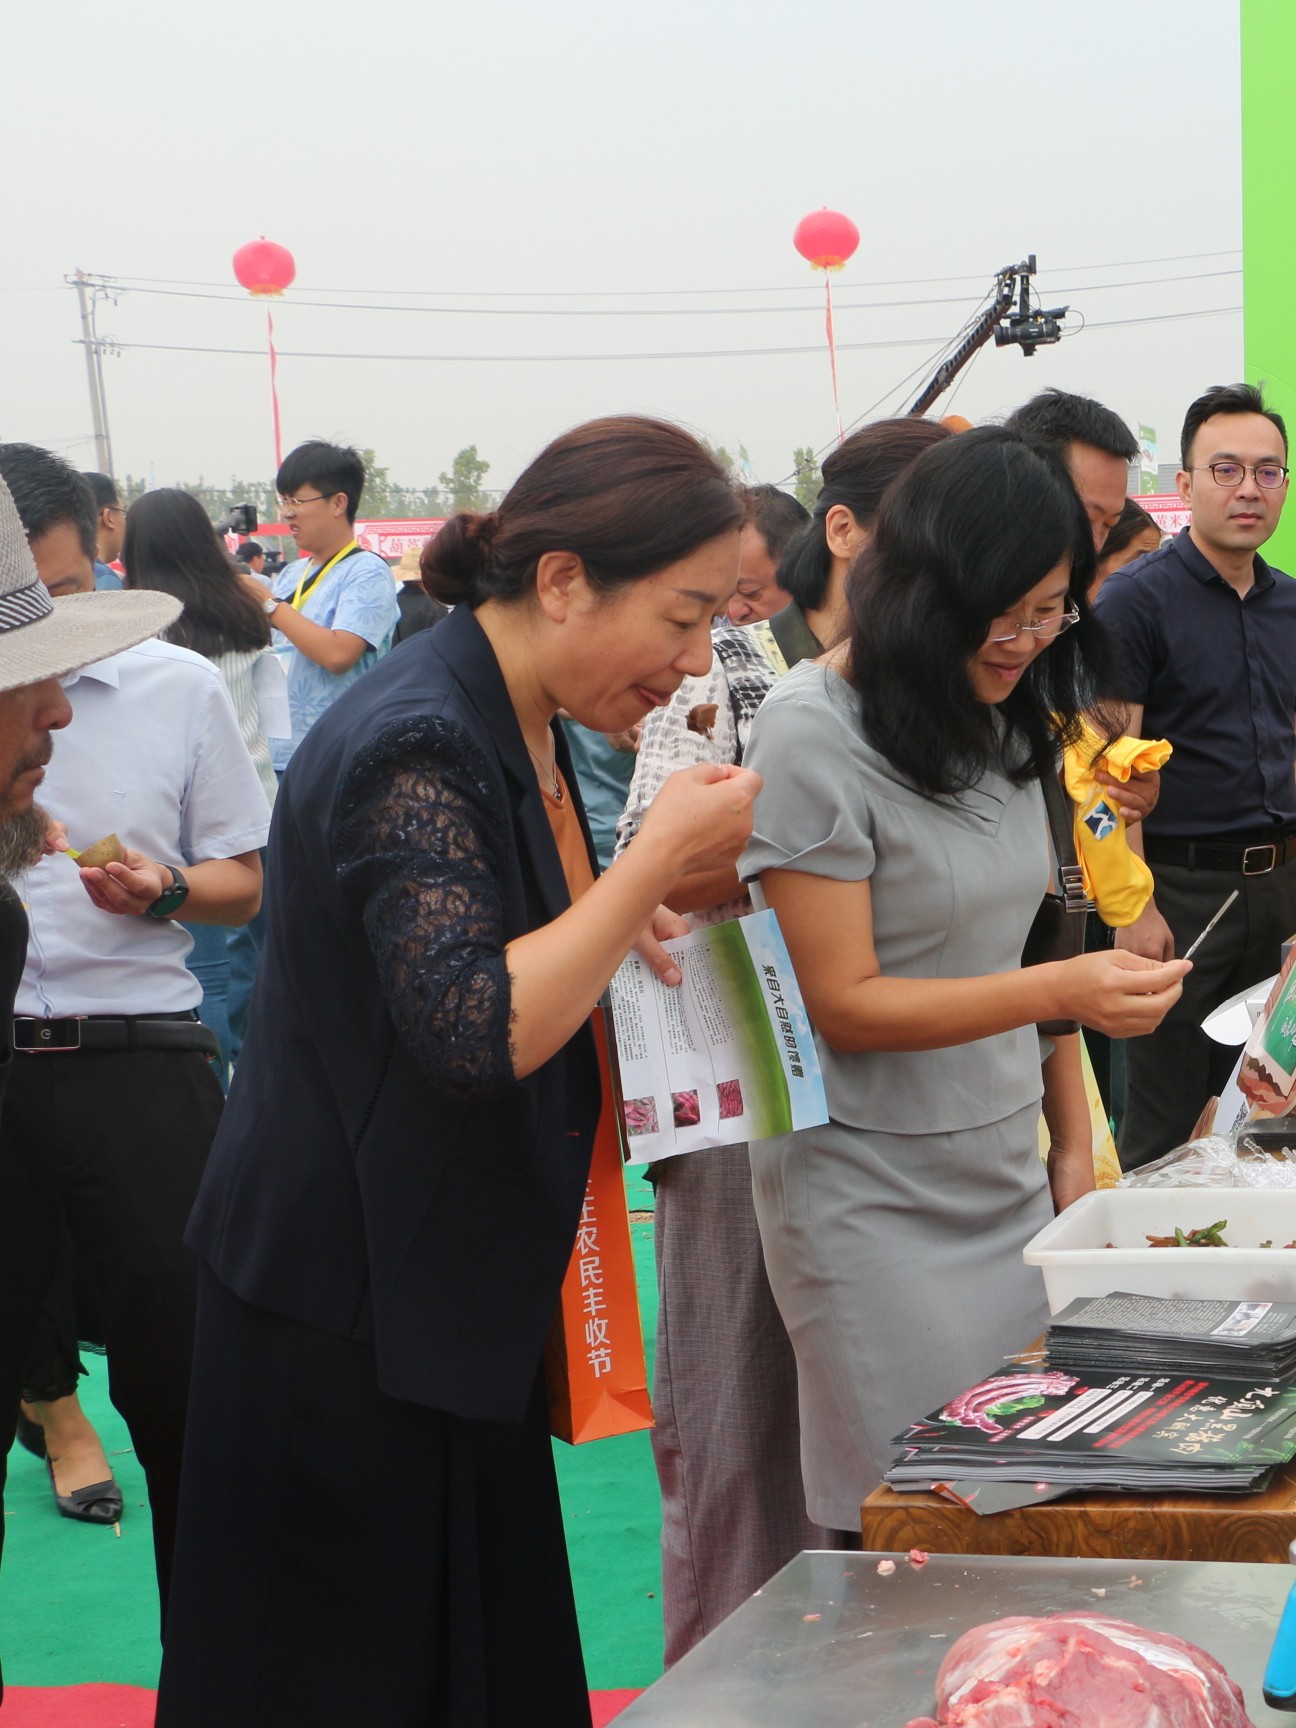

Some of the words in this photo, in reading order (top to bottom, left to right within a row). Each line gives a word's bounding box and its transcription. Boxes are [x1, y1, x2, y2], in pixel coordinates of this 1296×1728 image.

[762, 964, 804, 1078] 来自大自然的馈赠
[576, 1178, 613, 1379] 庄农民丰收节
[1152, 1395, 1228, 1439] 优惠大酬宾
